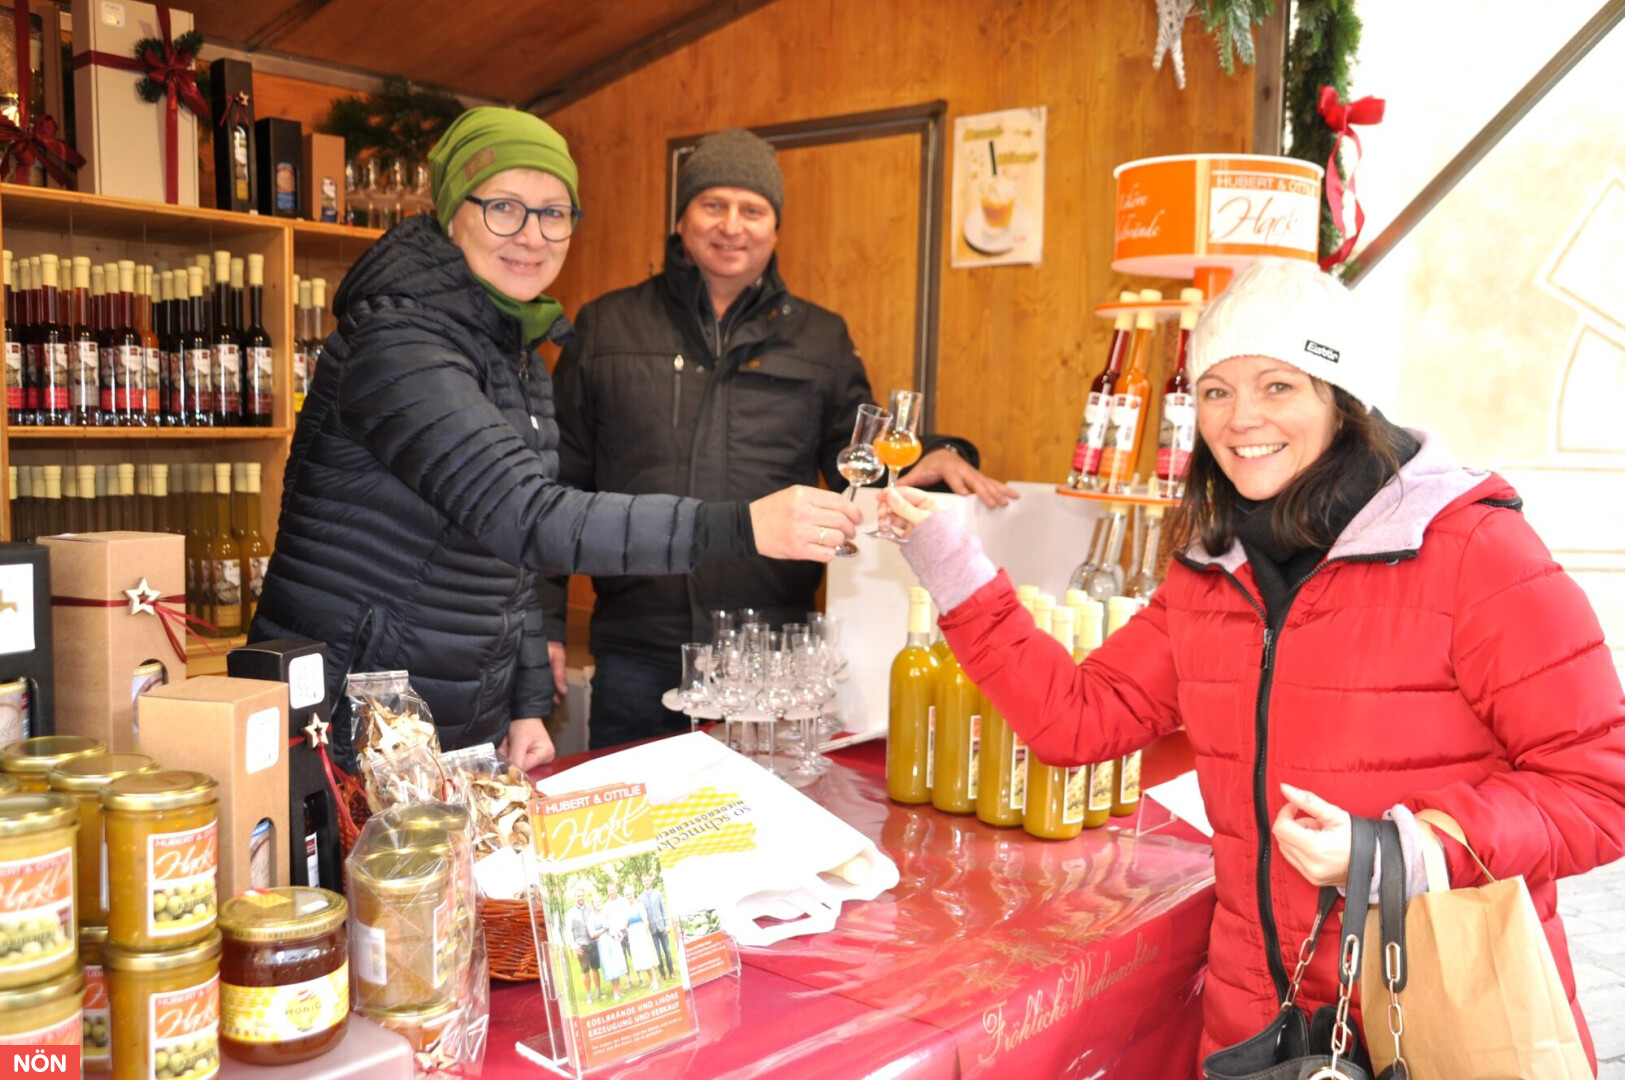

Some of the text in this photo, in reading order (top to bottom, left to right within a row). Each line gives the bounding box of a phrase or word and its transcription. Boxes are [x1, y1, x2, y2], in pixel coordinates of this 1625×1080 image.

[1216, 176, 1273, 189] HUBERT
[1277, 179, 1287, 191] &
[545, 795, 590, 814] HUBERT
[593, 794, 602, 804] &
[603, 784, 641, 802] OTTILIE
[285, 1002, 322, 1016] HONIG
[586, 991, 679, 1028] EDELBRÄNDE UND LIKÖRE
[588, 1017, 633, 1038] ERZEUGUNG
[634, 1011, 651, 1023] UND
[652, 1001, 680, 1017] VERKAUF
[978, 976, 1068, 1063] Fröhliche
